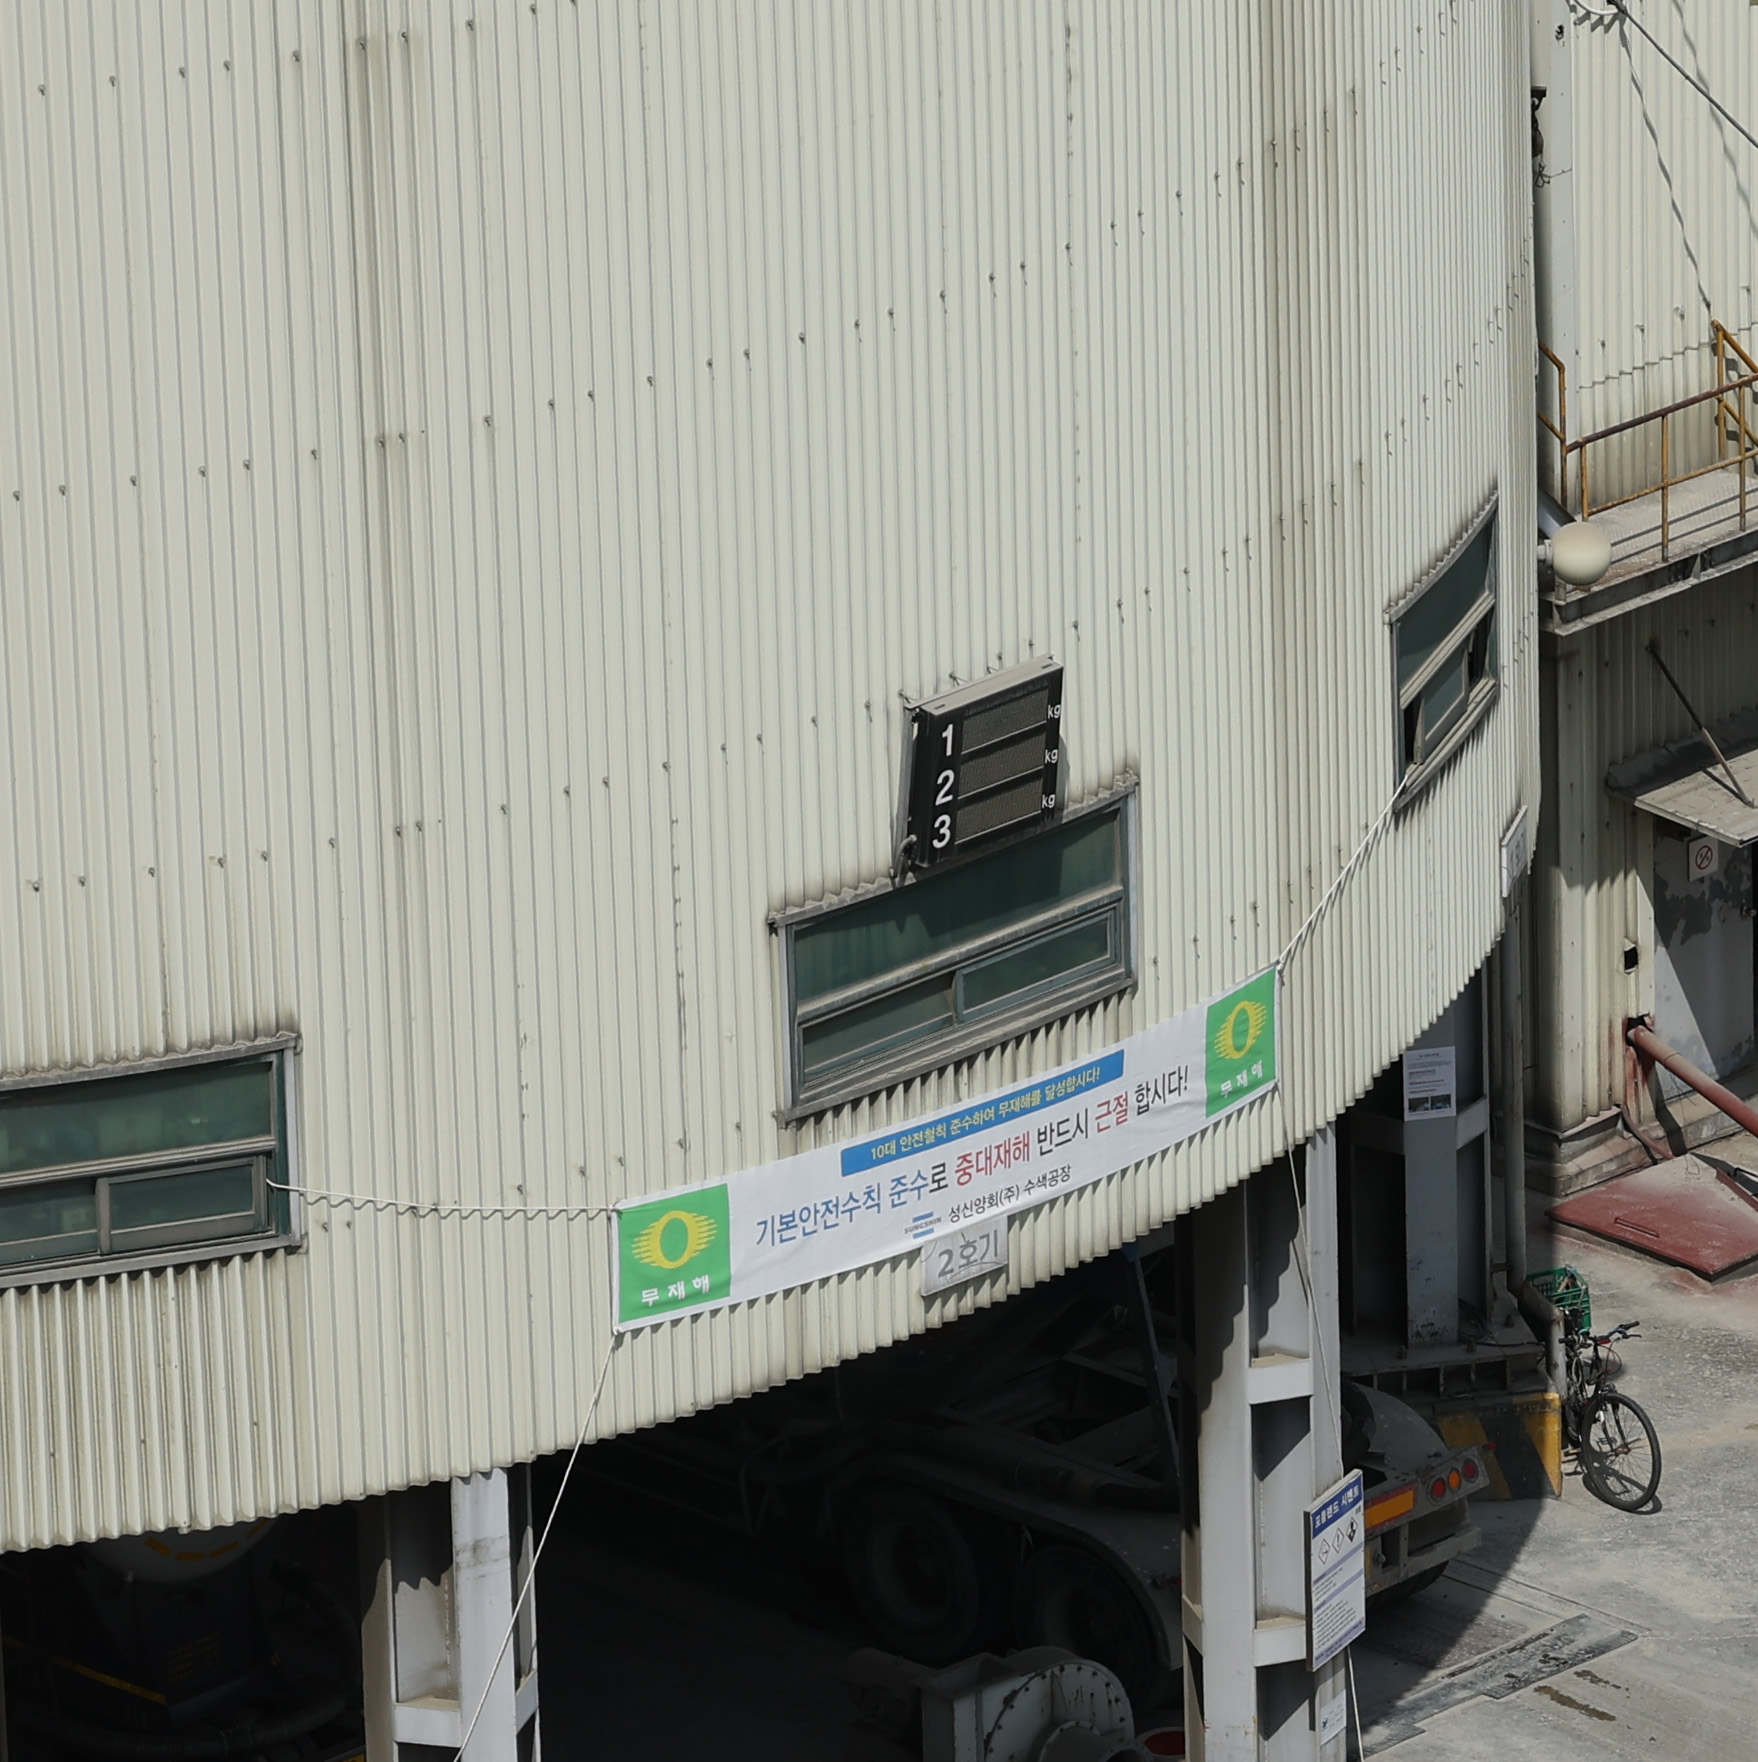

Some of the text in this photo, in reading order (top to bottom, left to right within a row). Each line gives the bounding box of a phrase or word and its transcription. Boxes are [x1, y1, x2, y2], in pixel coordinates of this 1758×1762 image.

[941, 704, 1061, 756] 1 kg
[935, 750, 1058, 806] 2 kg
[932, 794, 1055, 848] 3 kg
[1220, 1060, 1263, 1099] 무재해
[870, 1139, 897, 1160] 10대
[950, 1105, 995, 1135] 준수하여
[998, 1090, 1042, 1118] 무재해를
[1044, 1066, 1101, 1102] 달성합시다!
[756, 1065, 1188, 1247] 기본안전수칙 준수로 중대재해 반드시 근절 합시다!
[948, 1164, 1072, 1224] 성신양회(주) 수색공장
[904, 1216, 942, 1235] SUNGSHIN
[938, 1229, 998, 1278] 2호기
[641, 1274, 710, 1307] 무재해
